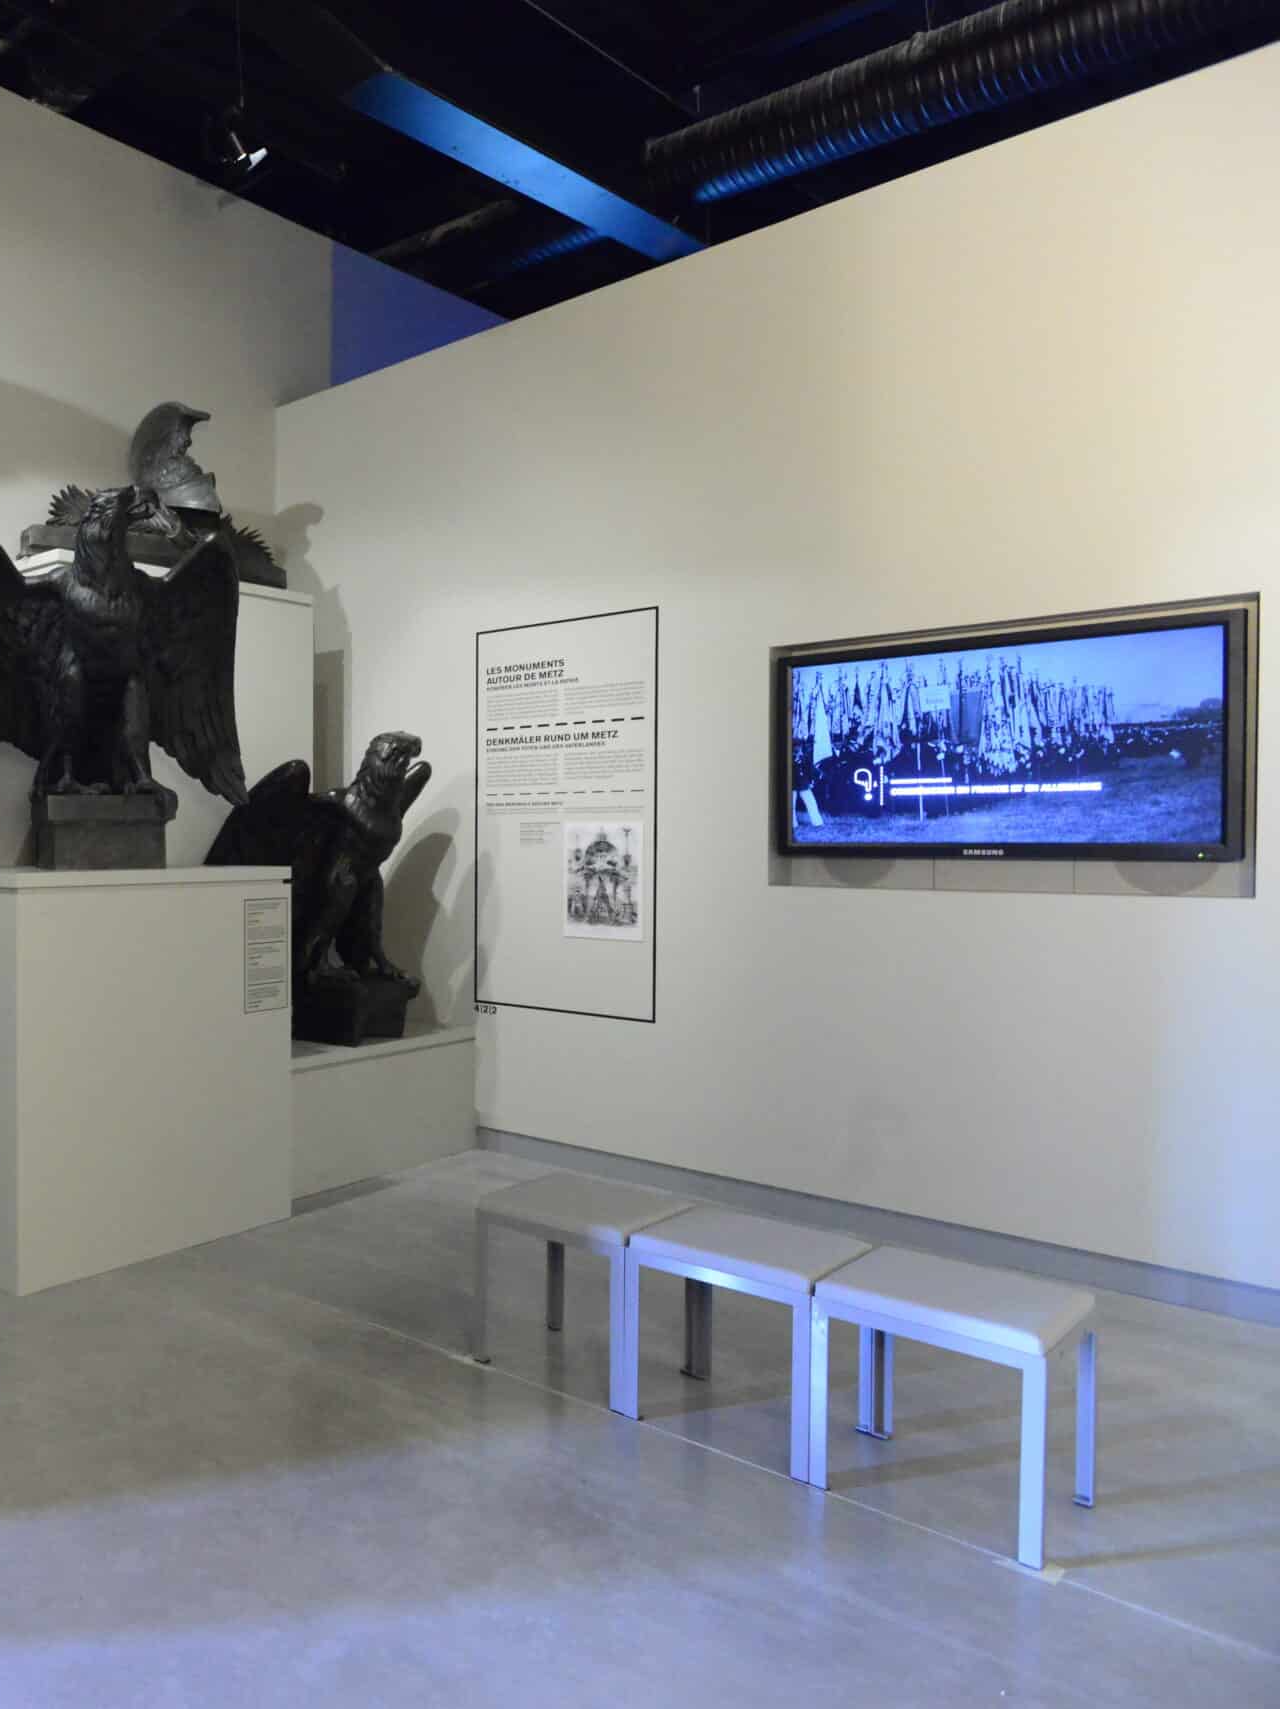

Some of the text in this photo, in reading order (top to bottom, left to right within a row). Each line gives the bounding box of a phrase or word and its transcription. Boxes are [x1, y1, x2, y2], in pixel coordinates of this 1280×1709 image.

[486, 659, 565, 675] LES MONUMENTS
[487, 674, 521, 685] AUTOUR
[524, 672, 537, 681] DE
[539, 669, 564, 679] METZ
[543, 733, 571, 743] RUND
[573, 732, 589, 741] UM
[591, 730, 619, 740] METZ
[962, 848, 1005, 856] SAMSUNG
